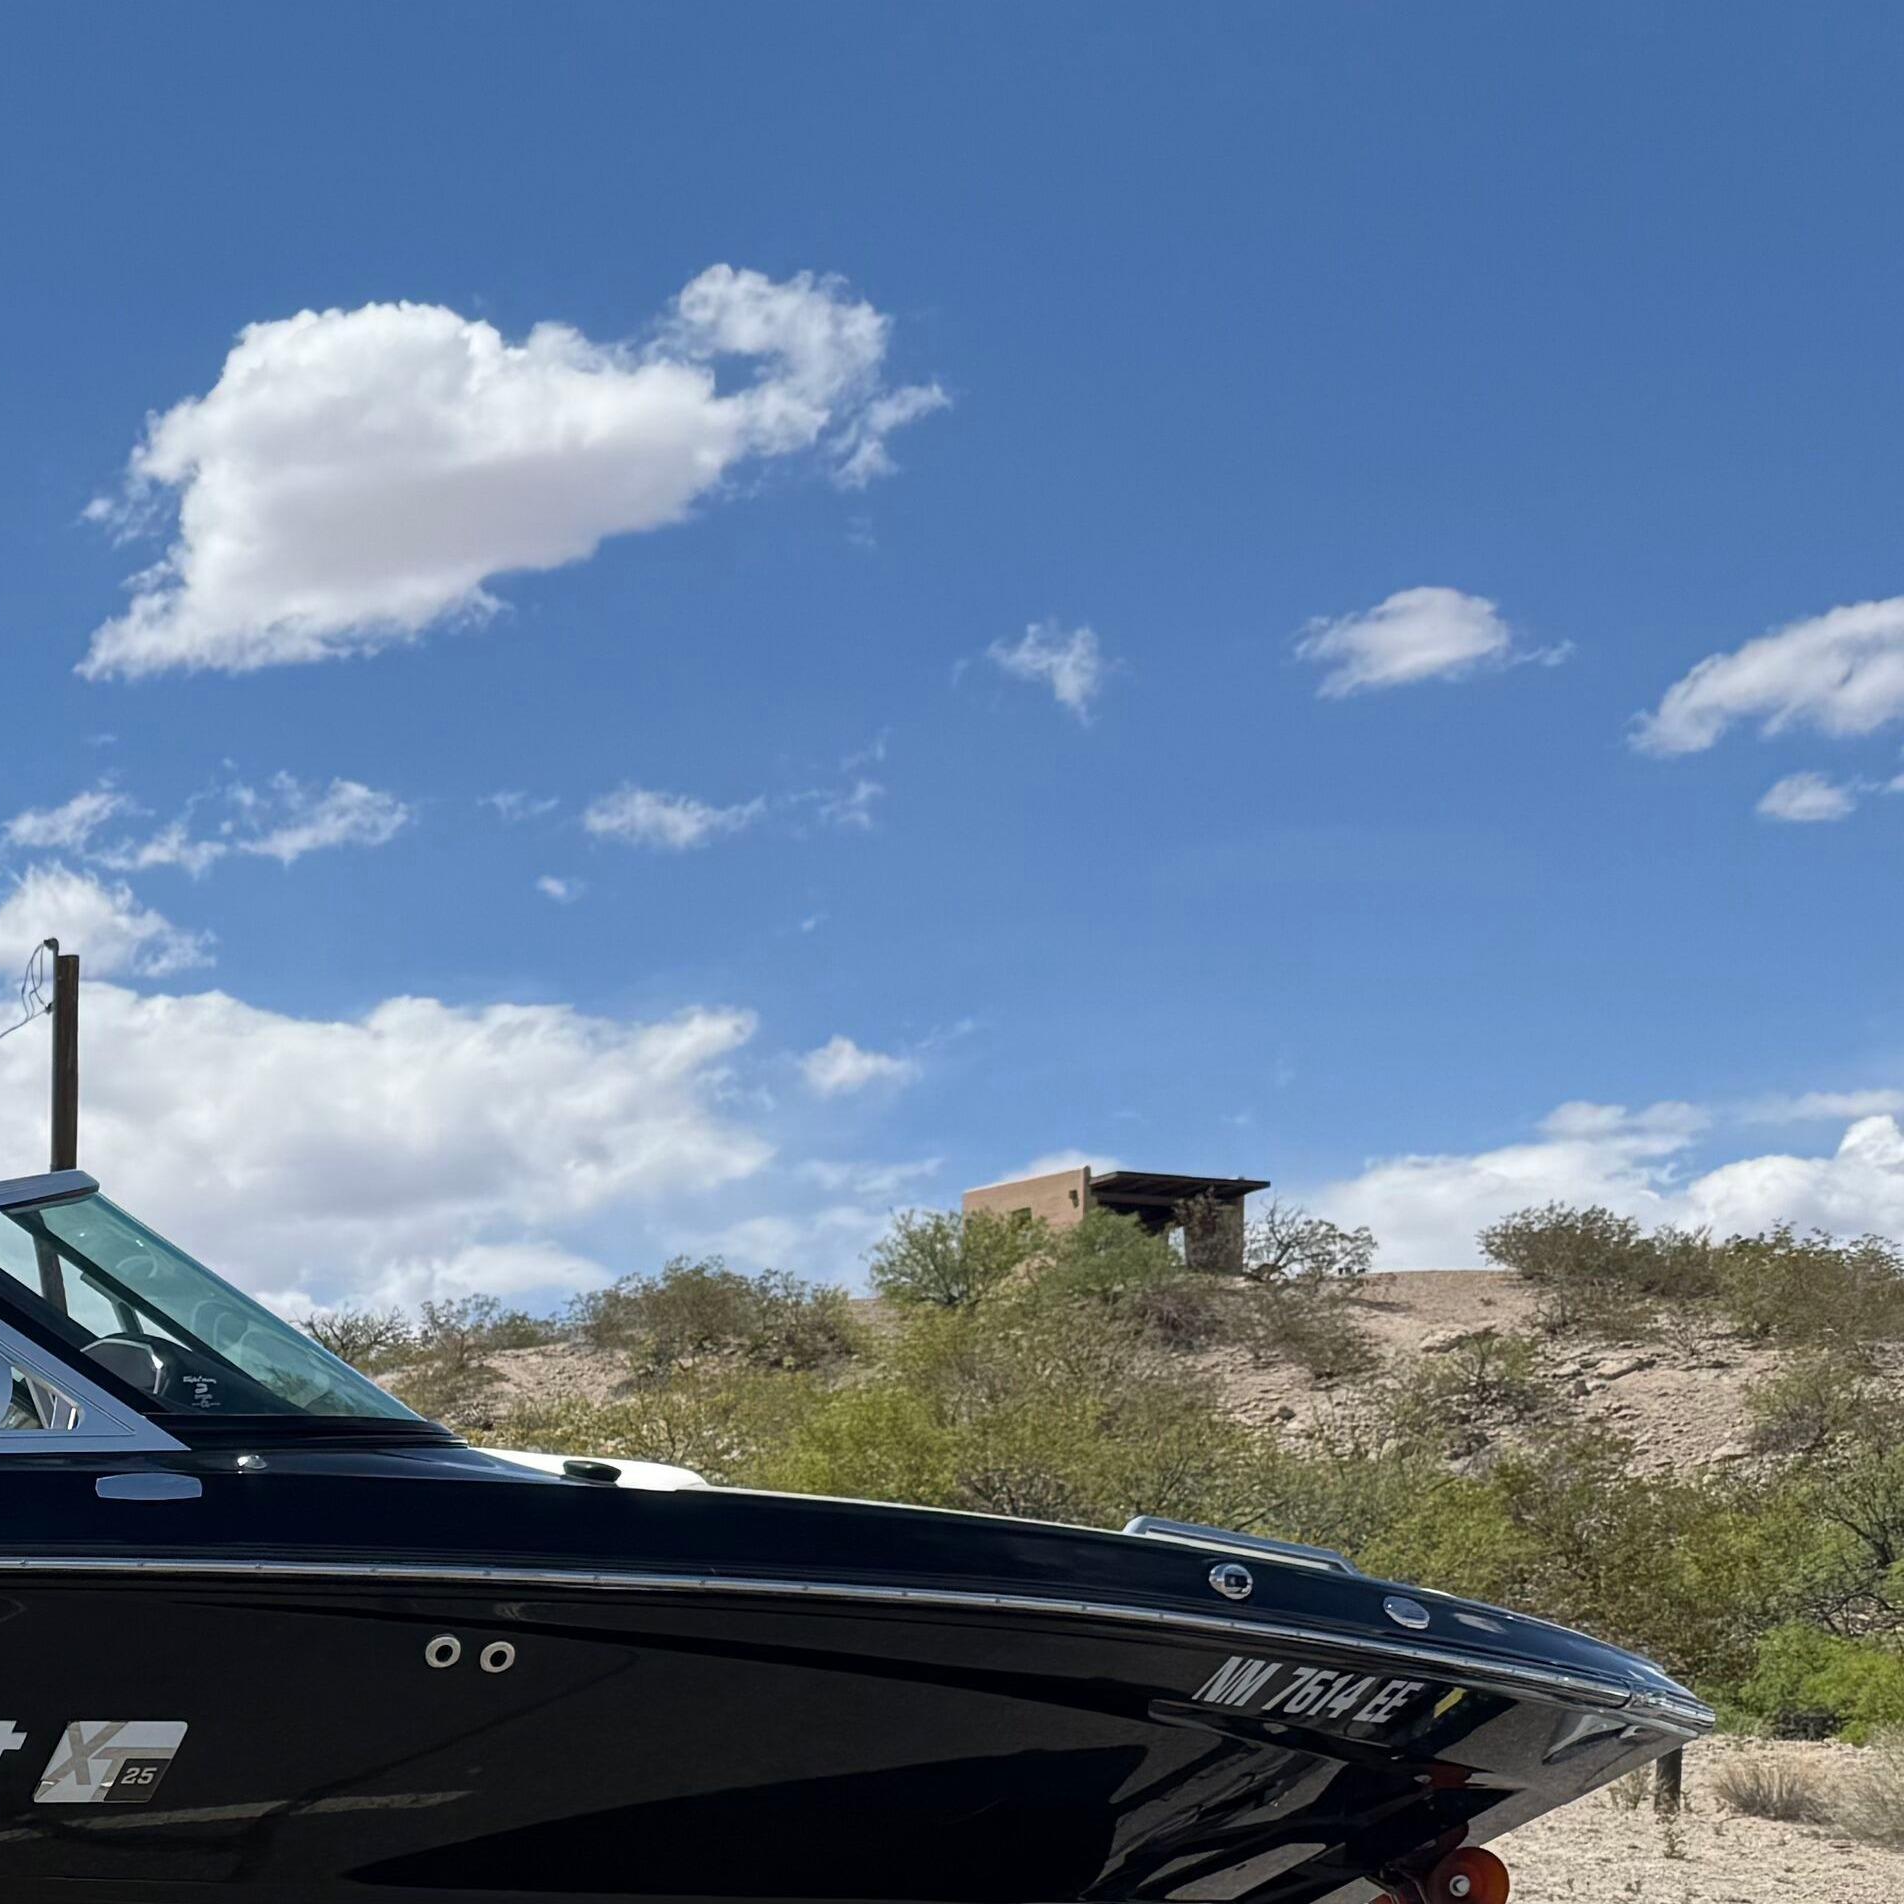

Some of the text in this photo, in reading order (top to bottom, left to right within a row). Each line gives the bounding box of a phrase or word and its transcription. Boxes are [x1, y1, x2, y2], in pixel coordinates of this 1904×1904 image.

[1192, 1656, 1425, 1723] NM 7614 EE
[121, 1767, 158, 1785] 25
